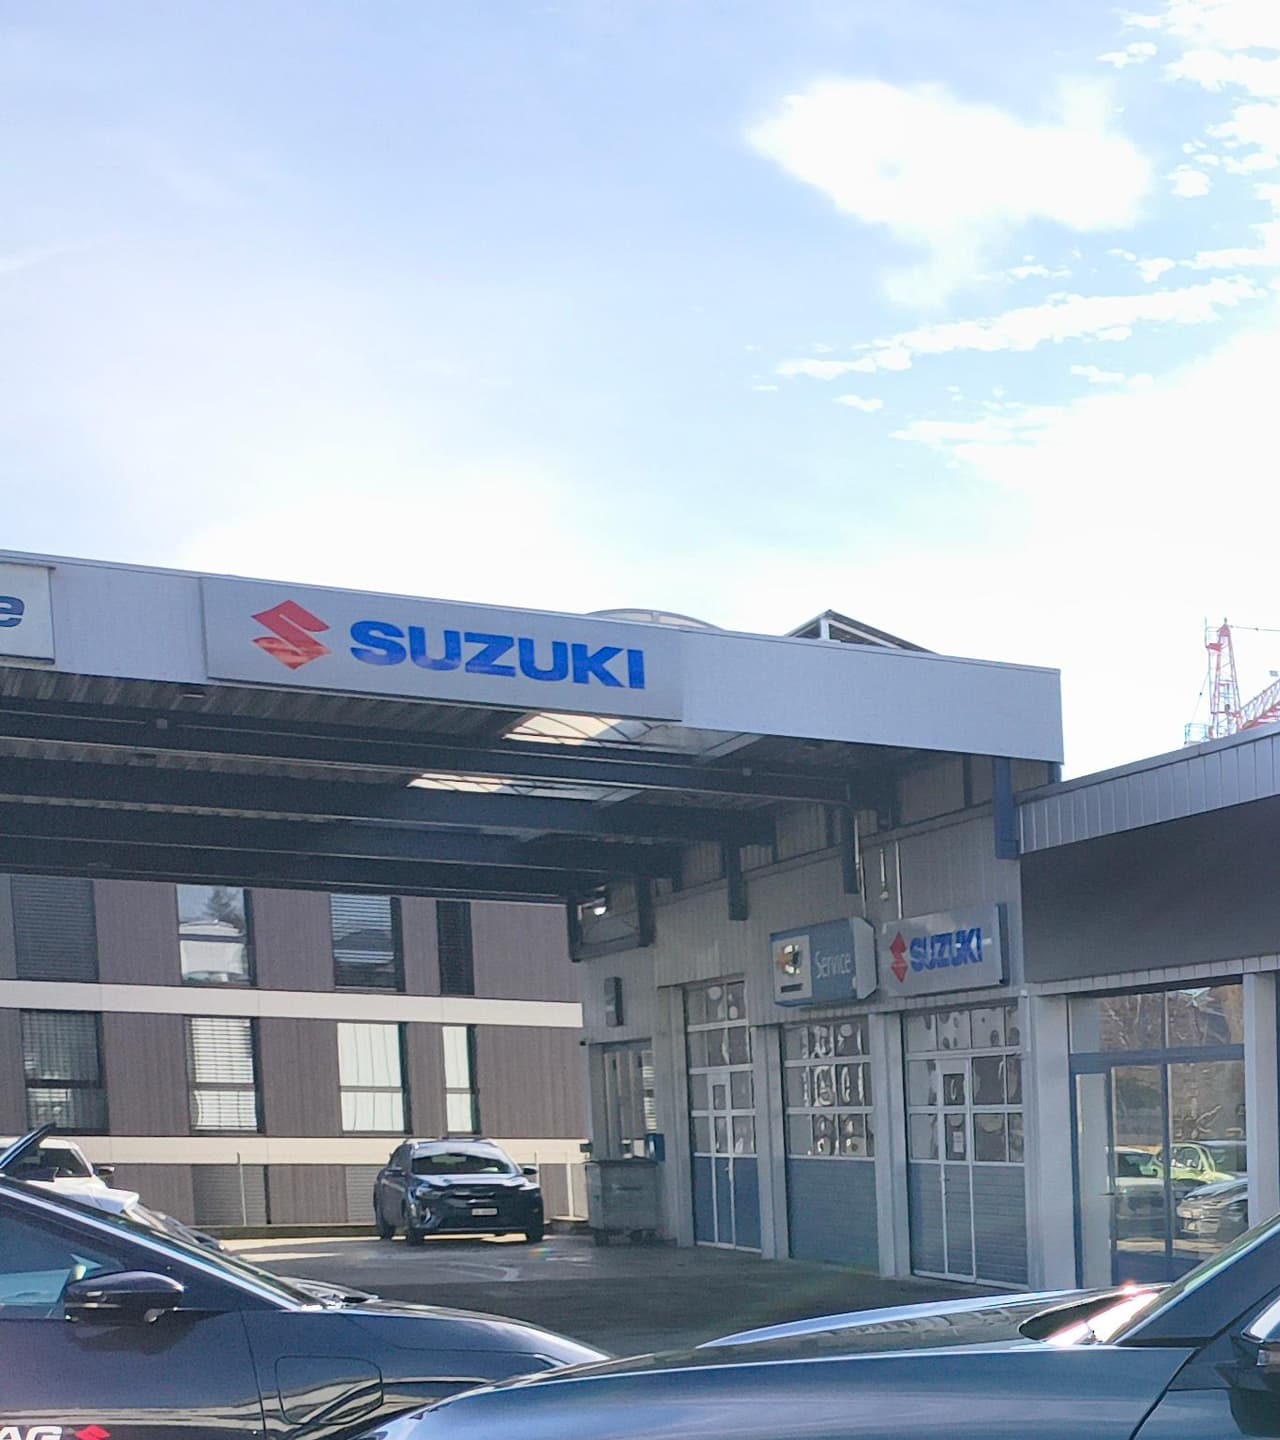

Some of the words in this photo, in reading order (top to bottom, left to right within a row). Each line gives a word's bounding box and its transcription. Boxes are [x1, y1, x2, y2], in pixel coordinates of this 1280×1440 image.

[350, 620, 646, 689] SUZUKI
[815, 951, 851, 979] Service
[909, 927, 983, 973] SUZUKI
